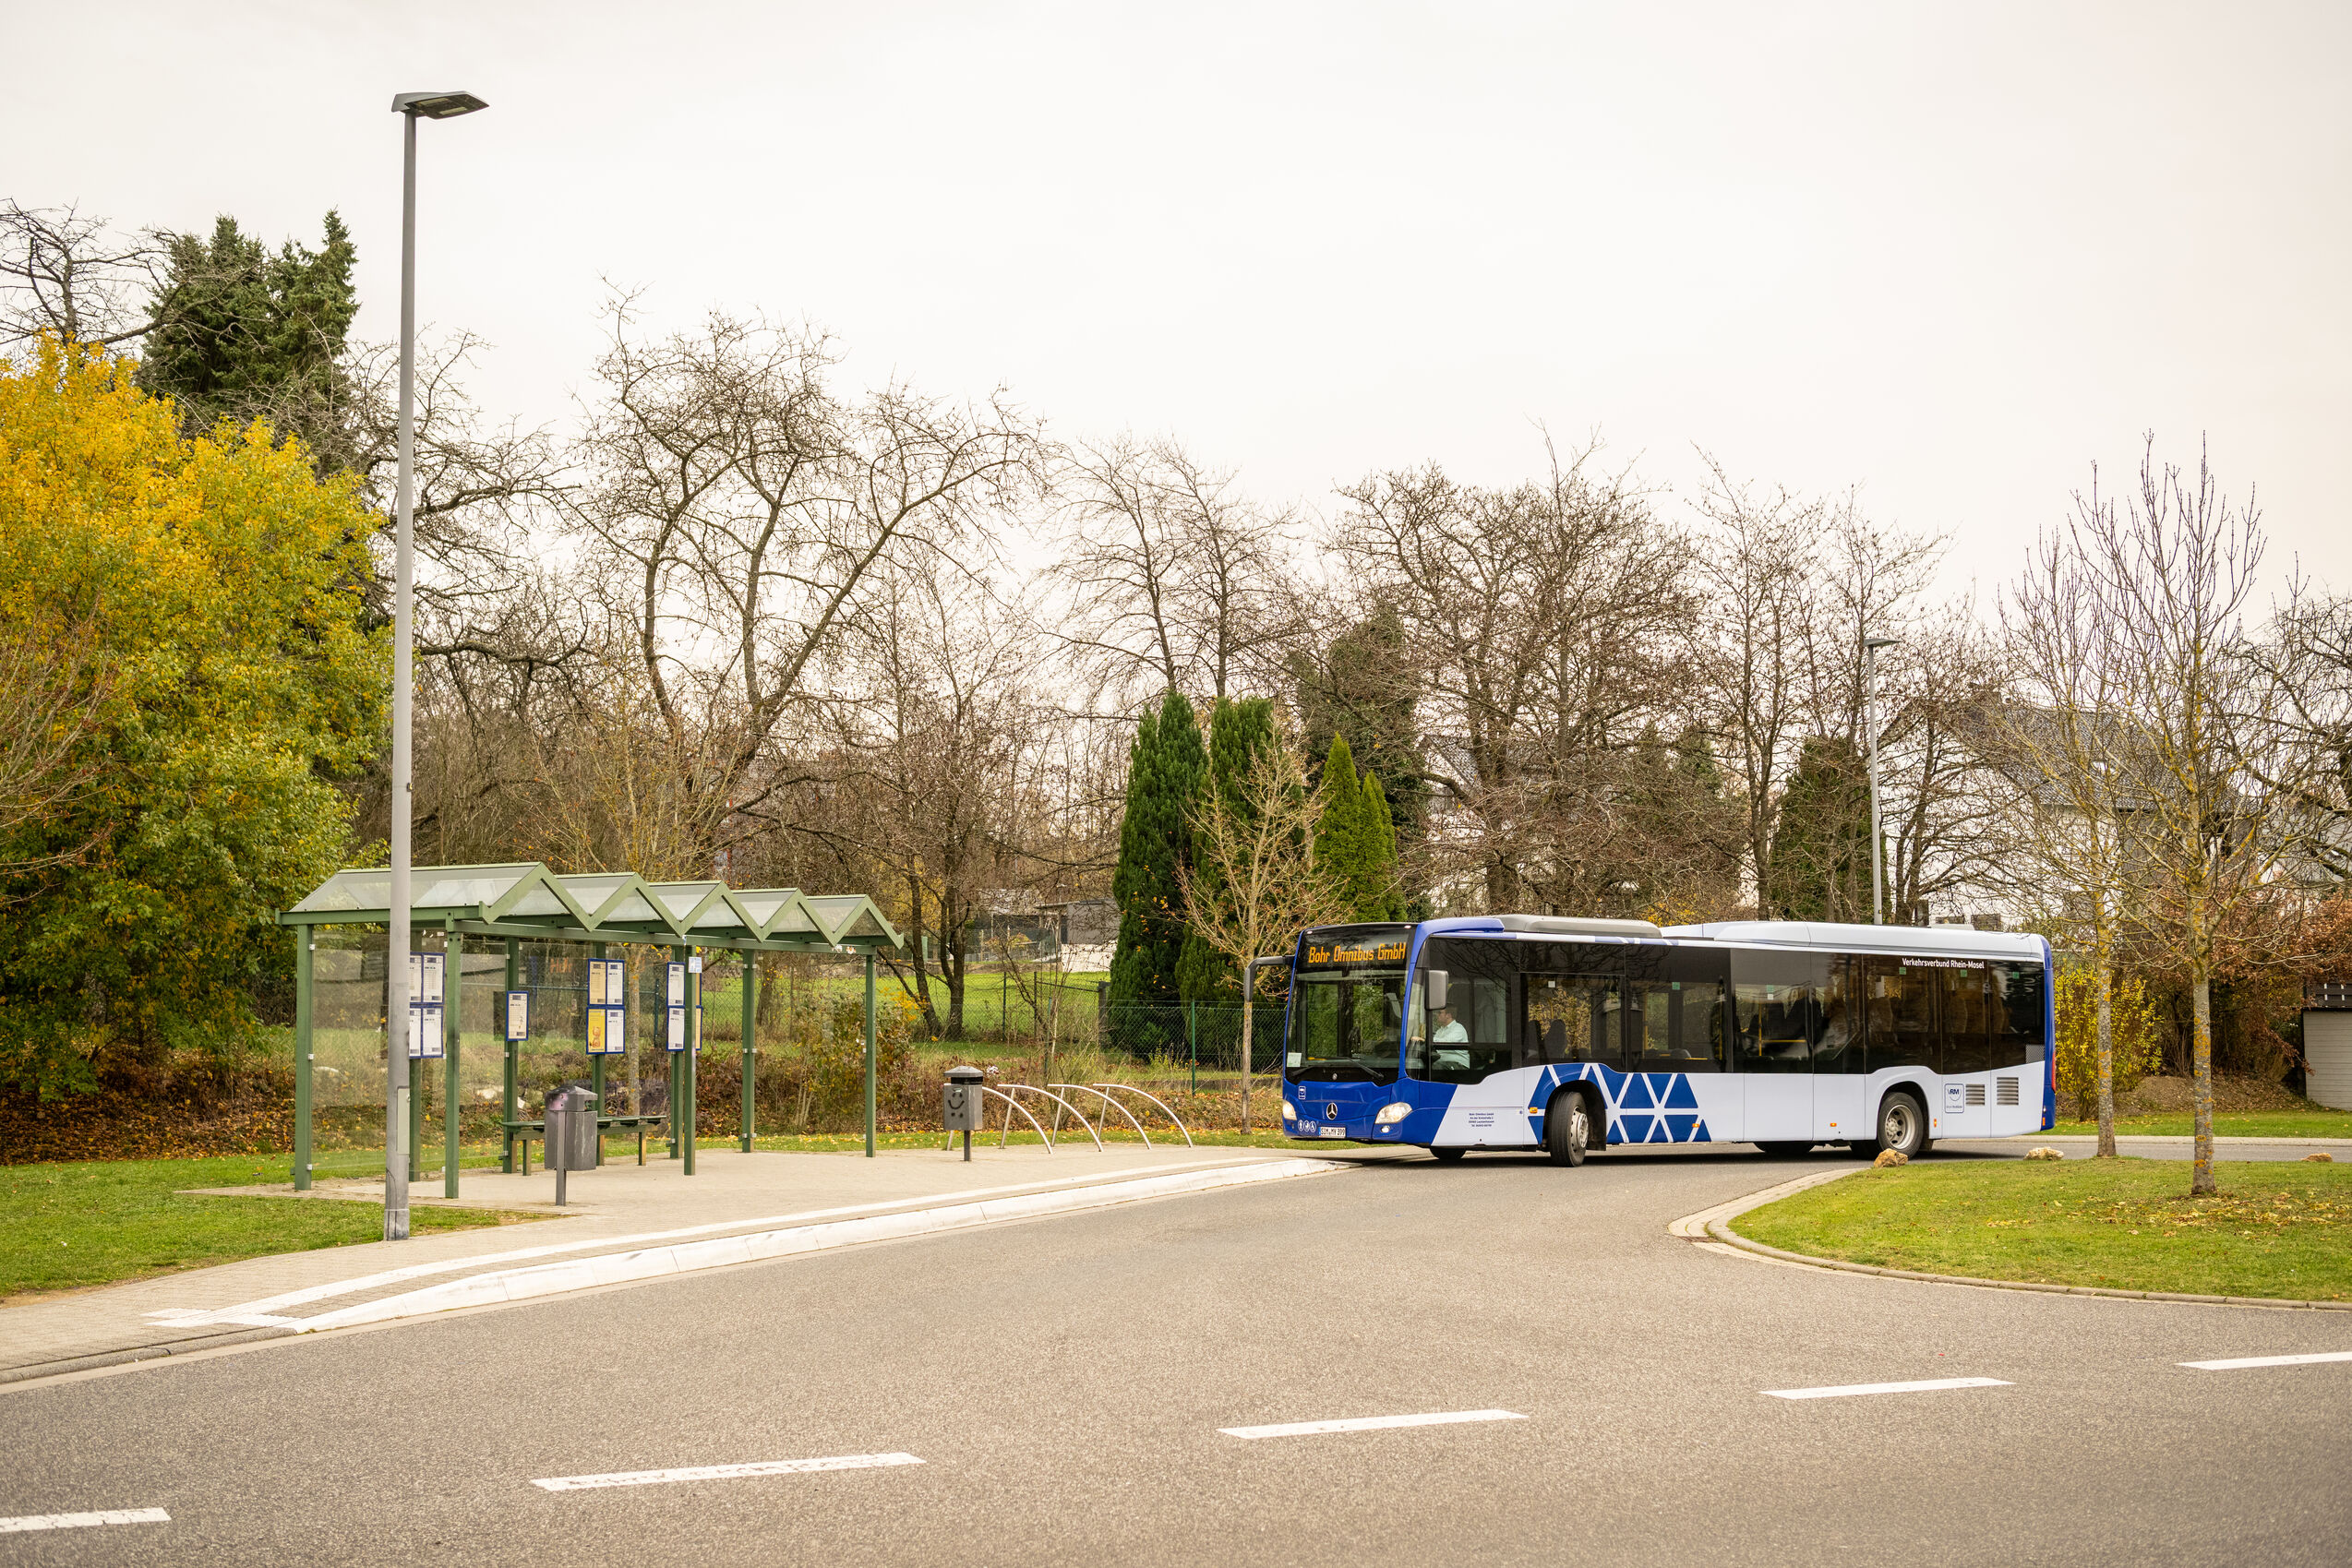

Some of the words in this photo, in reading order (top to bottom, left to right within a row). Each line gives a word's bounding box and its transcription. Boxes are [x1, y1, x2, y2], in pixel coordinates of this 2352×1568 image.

[1308, 947, 1330, 963] Bohr
[1334, 945, 1374, 962] Omnibus
[1377, 942, 1406, 960] GmbH
[1902, 958, 1950, 967] Verkehrsverbund
[1950, 960, 1985, 969] Rhein-Mosel
